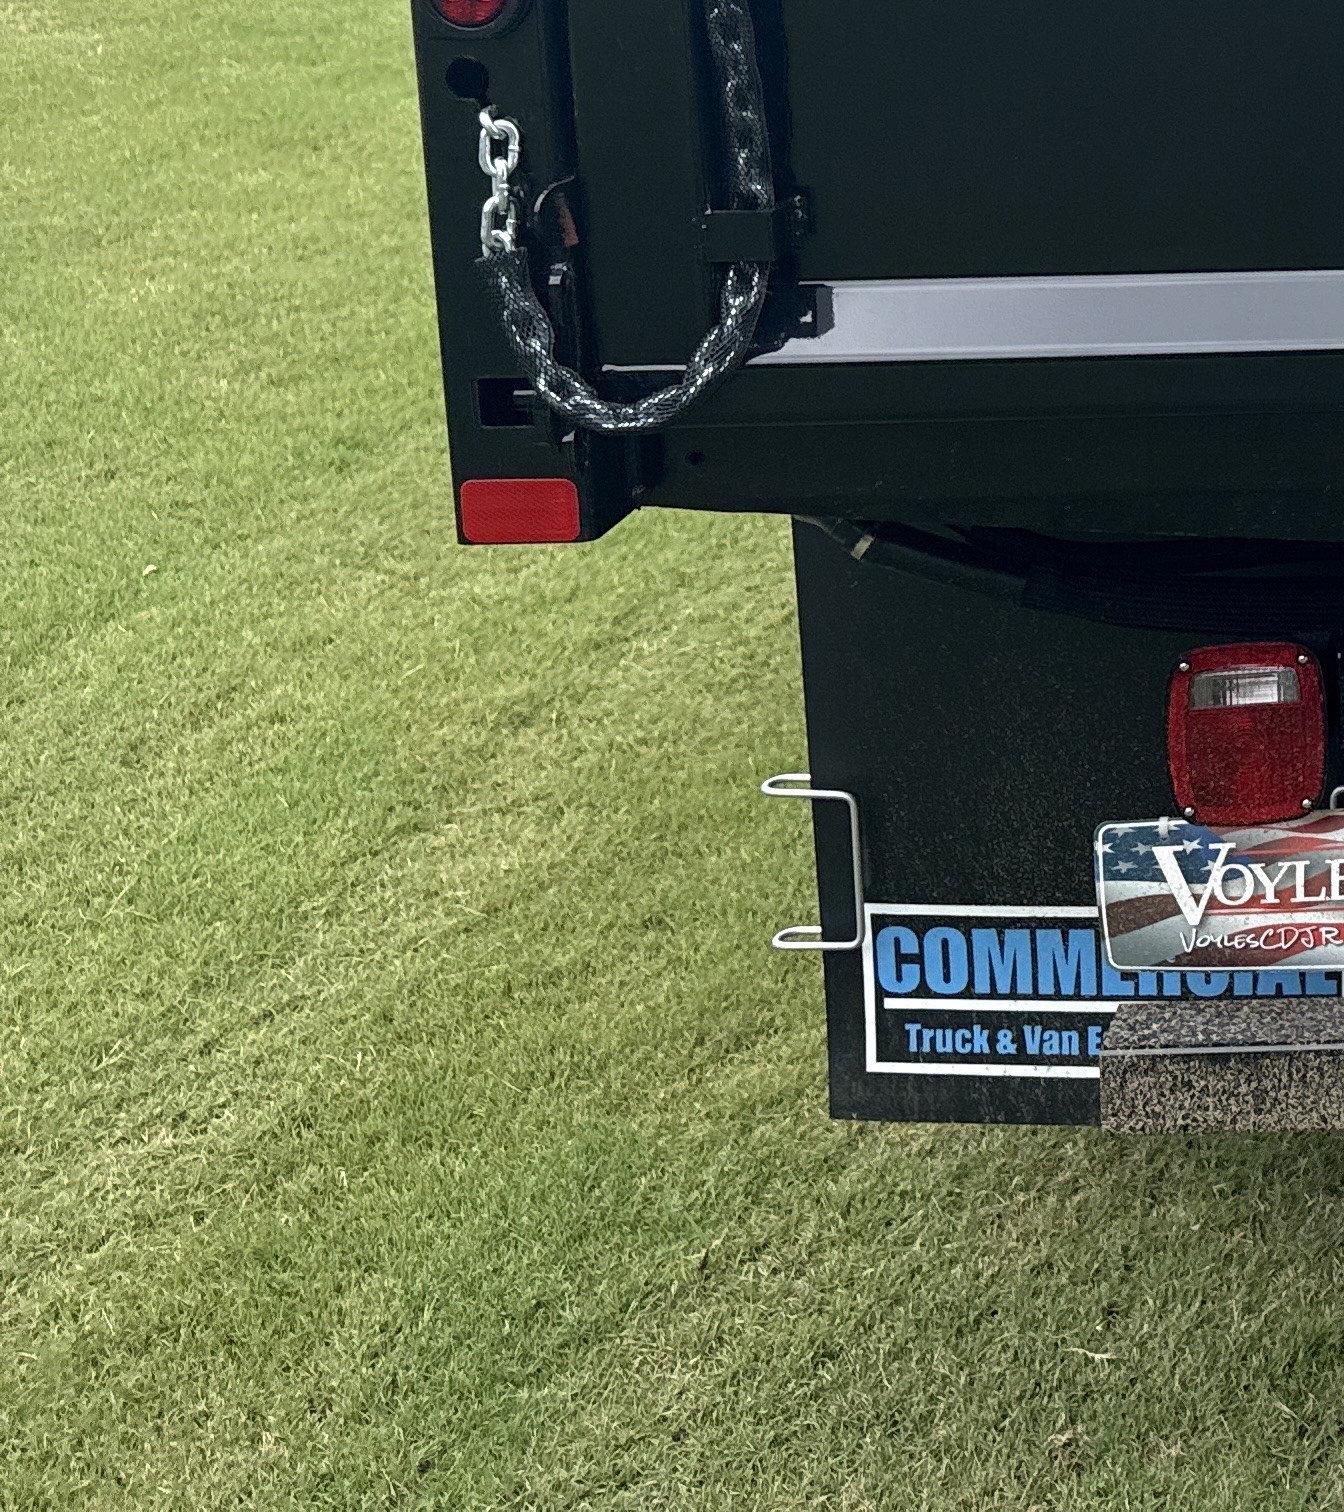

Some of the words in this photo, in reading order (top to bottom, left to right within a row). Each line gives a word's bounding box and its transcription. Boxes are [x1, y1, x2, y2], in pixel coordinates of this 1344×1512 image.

[904, 1022, 990, 1054] Truck
[995, 1028, 1018, 1055] &
[1022, 1024, 1080, 1056] Van
